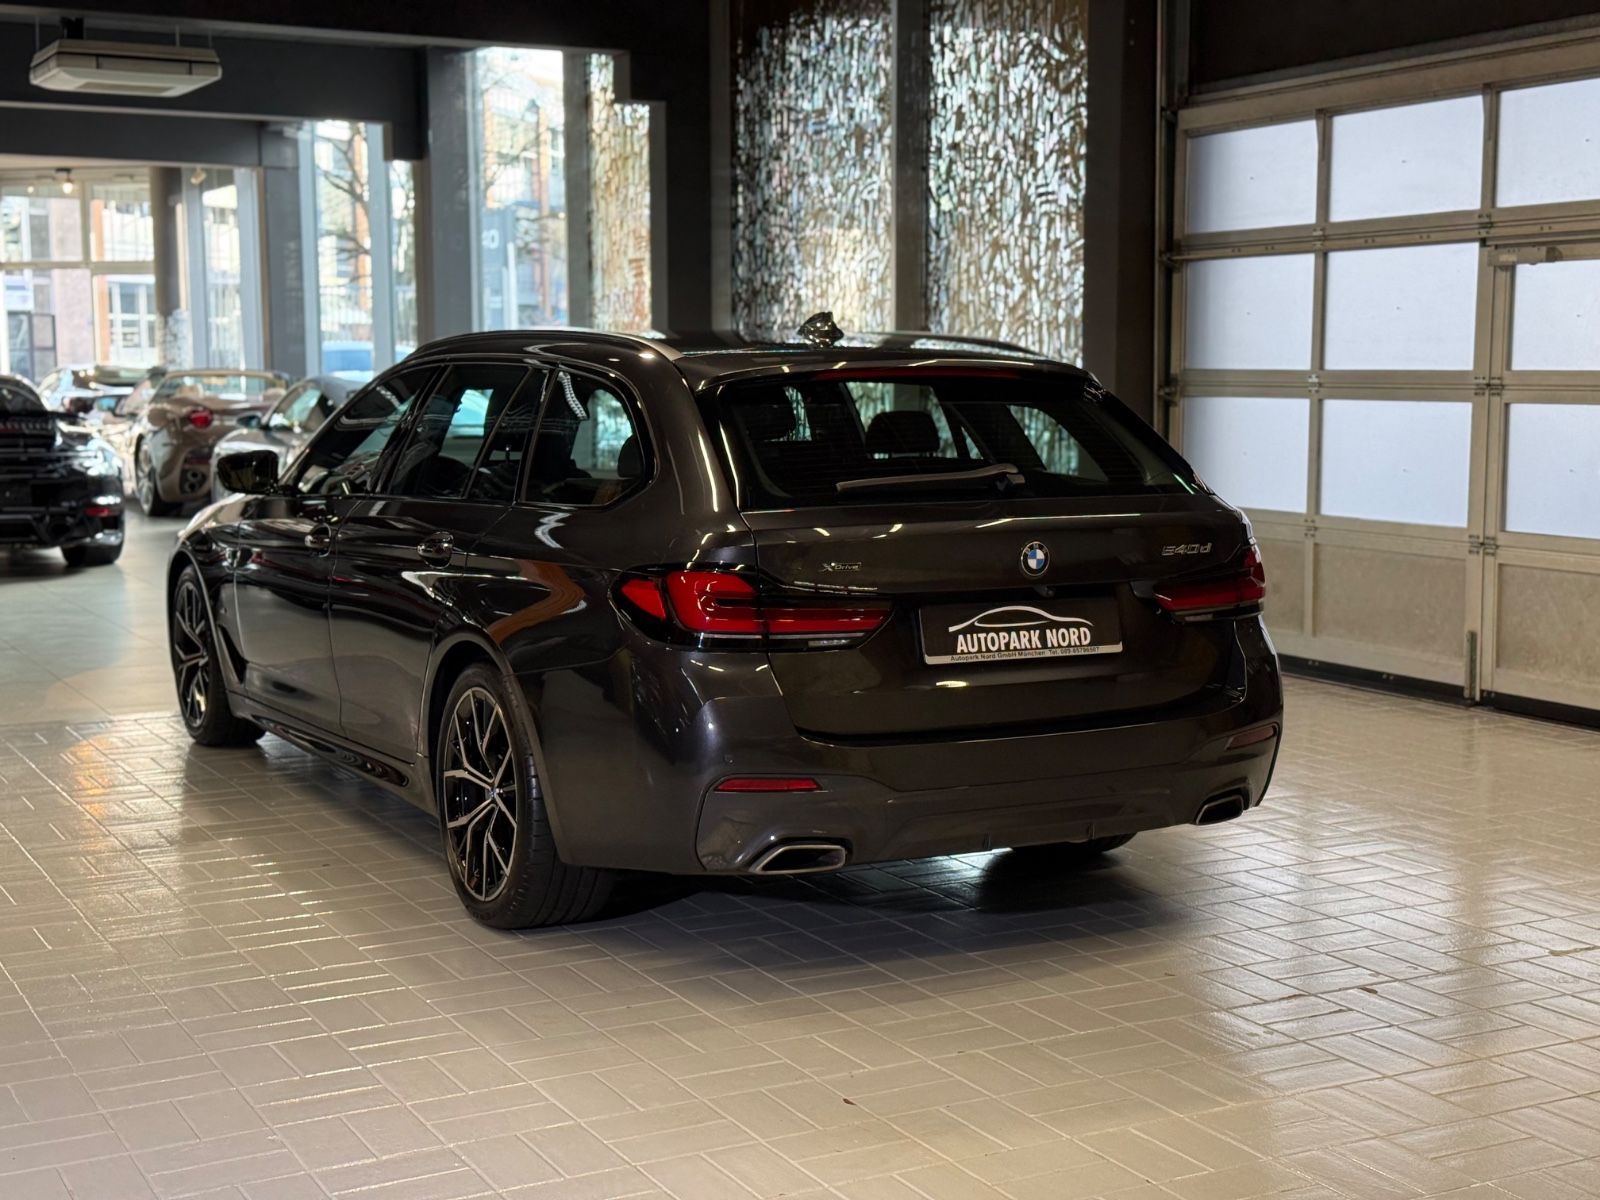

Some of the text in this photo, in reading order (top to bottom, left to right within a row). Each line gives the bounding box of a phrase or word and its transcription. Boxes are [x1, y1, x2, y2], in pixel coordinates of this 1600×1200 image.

[1161, 542, 1213, 556] 540d
[956, 627, 1091, 653] AUTOPARK NORD
[950, 653, 979, 662] Autopark
[980, 652, 996, 660] Nord
